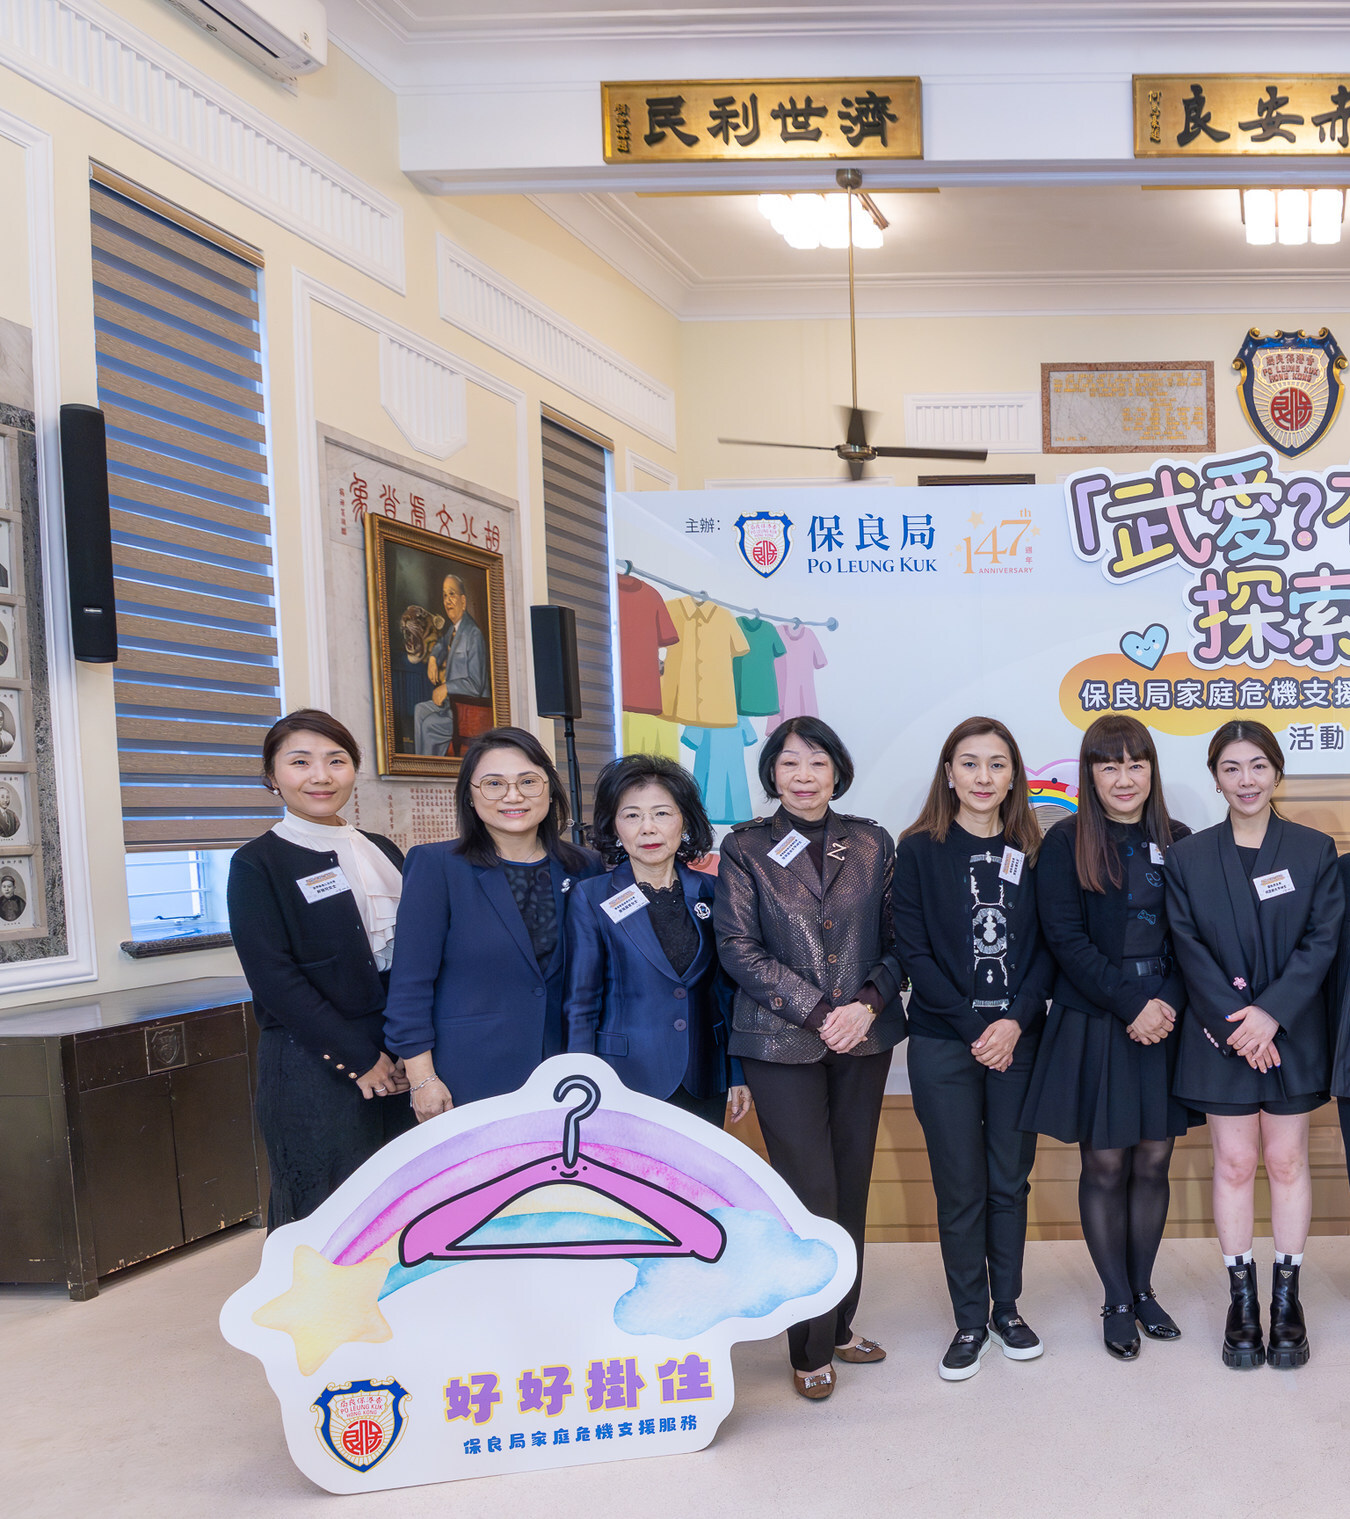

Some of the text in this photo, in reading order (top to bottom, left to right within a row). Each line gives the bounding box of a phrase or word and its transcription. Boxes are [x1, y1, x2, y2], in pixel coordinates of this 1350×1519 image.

[807, 513, 936, 553] 保良局
[836, 558, 894, 574] LEUNG
[900, 557, 938, 573] KUK
[463, 1414, 699, 1455] 保良局家庭危機支援服務
